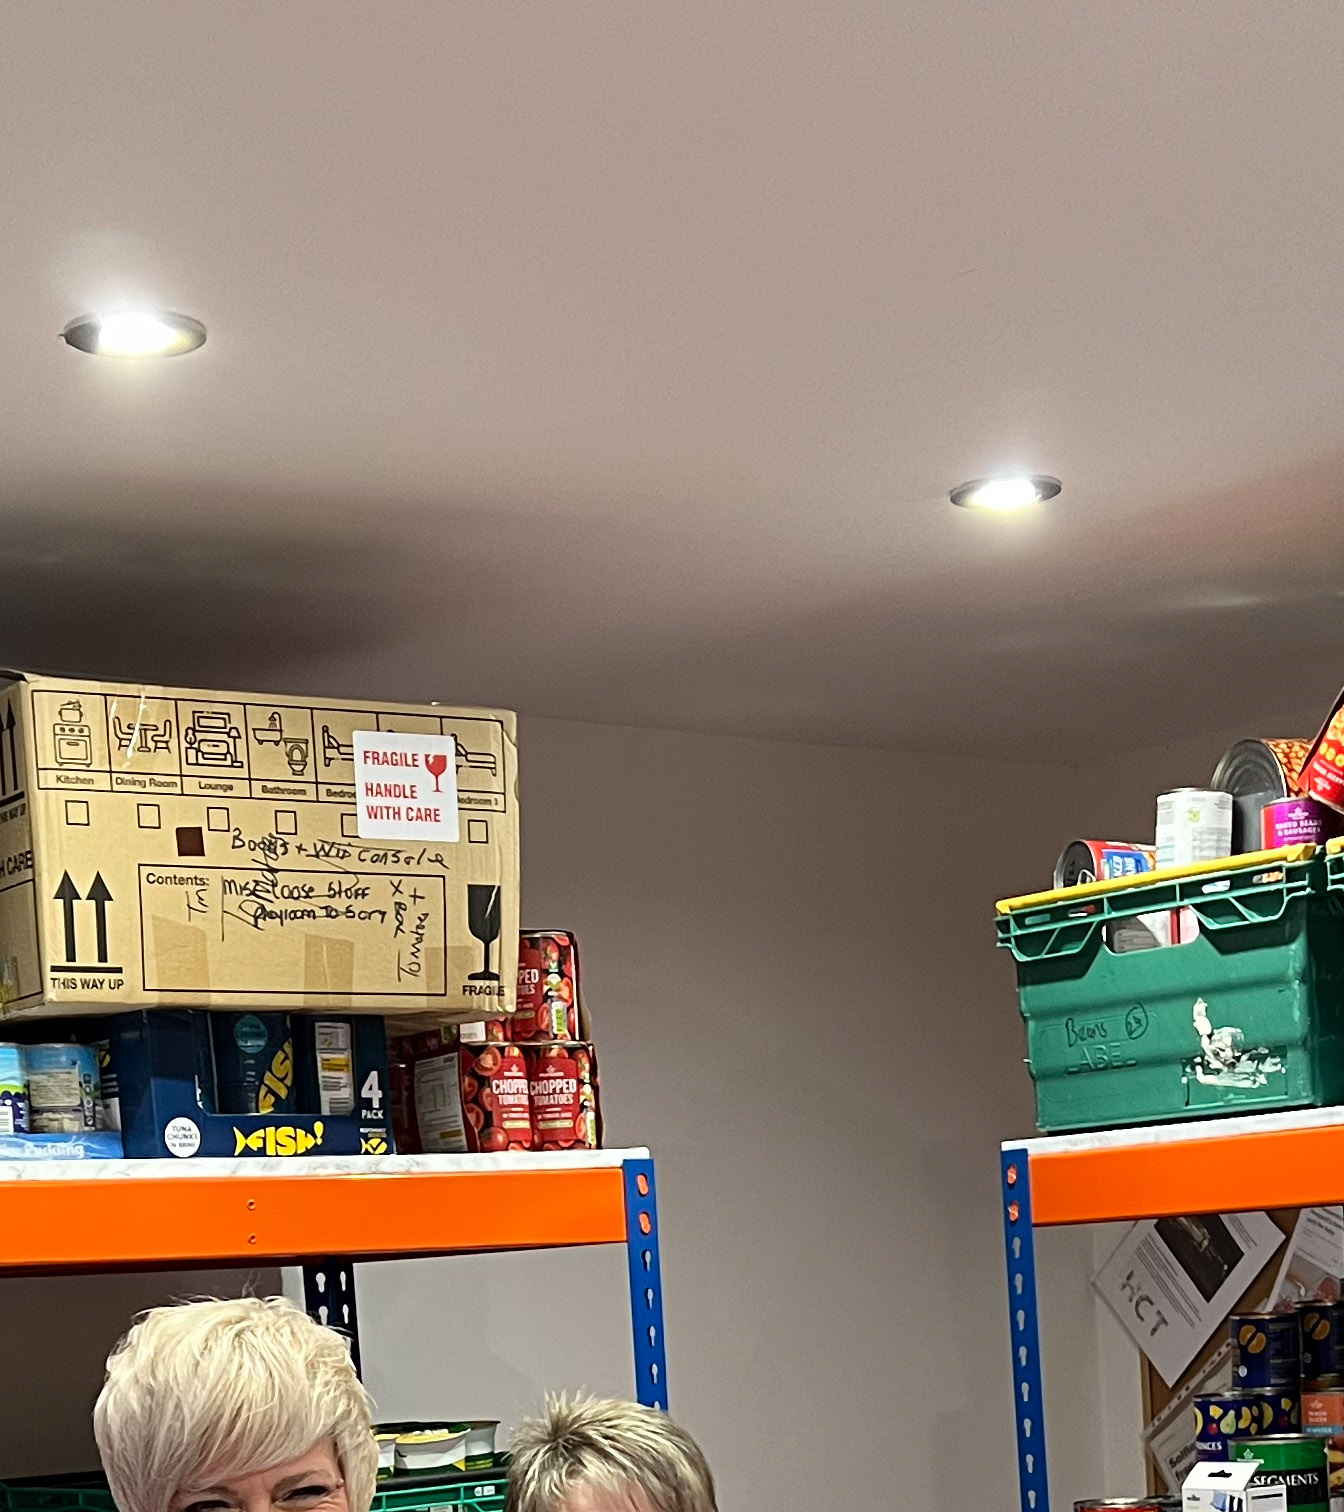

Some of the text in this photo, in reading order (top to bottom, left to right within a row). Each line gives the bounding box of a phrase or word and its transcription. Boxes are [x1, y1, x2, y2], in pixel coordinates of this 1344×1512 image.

[363, 750, 420, 768] FRAGILE
[55, 774, 95, 786] Kitchen
[115, 775, 178, 790] Dining Room
[198, 780, 234, 793] Lounge
[261, 784, 307, 796] Bathroom
[365, 782, 418, 800] HANDLE
[366, 805, 441, 823] WITH CARE
[6, 850, 34, 875] CARE
[146, 873, 210, 888] Contents:
[51, 978, 125, 990] THIS WAY UP
[463, 984, 505, 996] FRAGILE
[1065, 1017, 1108, 1047] Beans
[258, 1037, 294, 1115] FIS
[361, 1070, 383, 1109] 4
[530, 1078, 577, 1095] CHOPPED
[533, 1093, 574, 1105] TOMATOES
[361, 1109, 384, 1120] PACK
